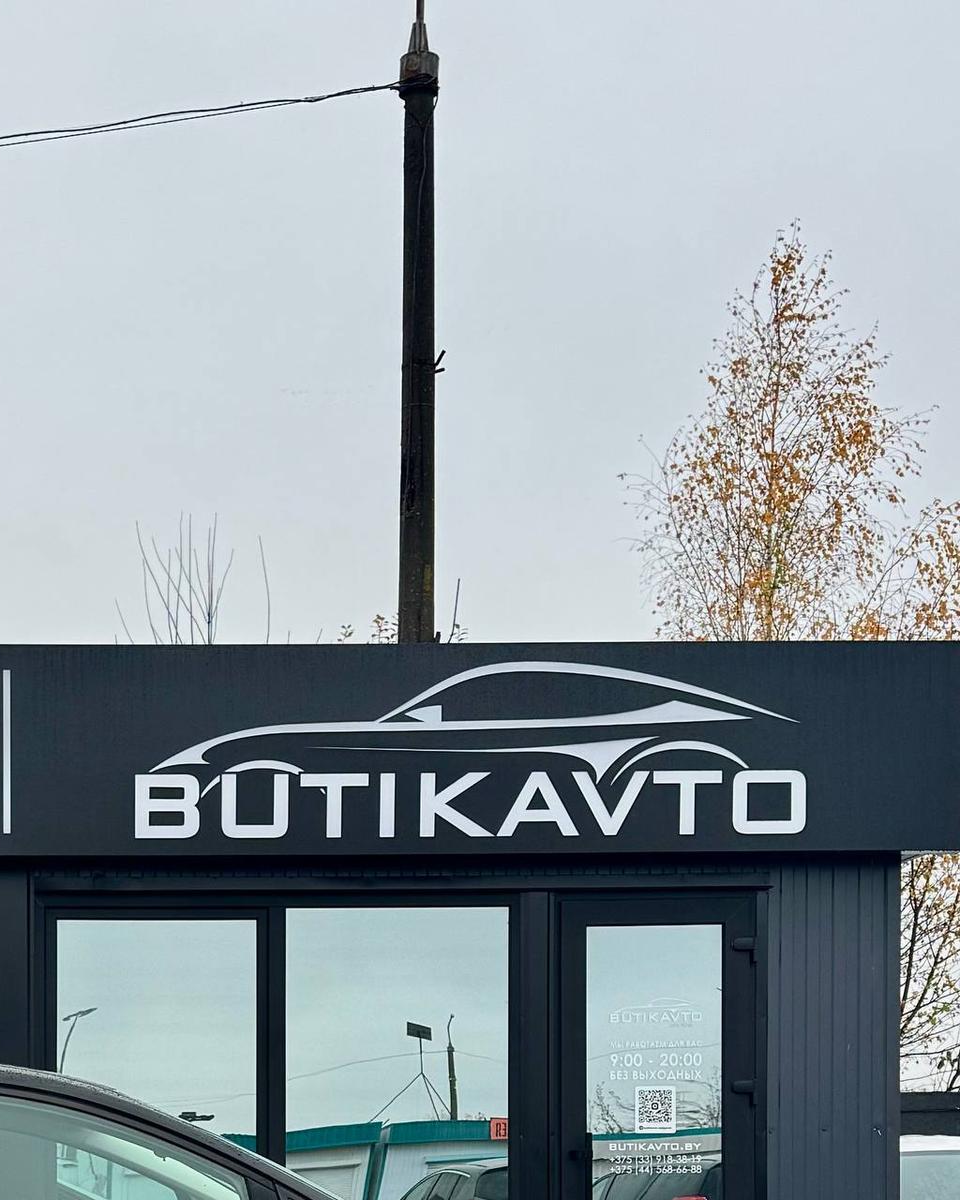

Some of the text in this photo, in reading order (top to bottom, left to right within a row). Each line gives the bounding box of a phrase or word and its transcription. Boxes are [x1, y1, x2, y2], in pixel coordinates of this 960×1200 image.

[134, 768, 807, 839] BUTIKAVTO
[609, 1011, 702, 1023] BUTIKAVTO
[610, 1053, 643, 1067] 9:00
[659, 1053, 702, 1067] 20:00
[609, 1070, 702, 1081] БЕЗ ВЫХОДНЫХ
[609, 1143, 702, 1151] BUTIKAVTO.BY
[609, 1154, 702, 1166] +375 (33) 918-38-19
[609, 1165, 702, 1176] +375 (44) 568-66-88
